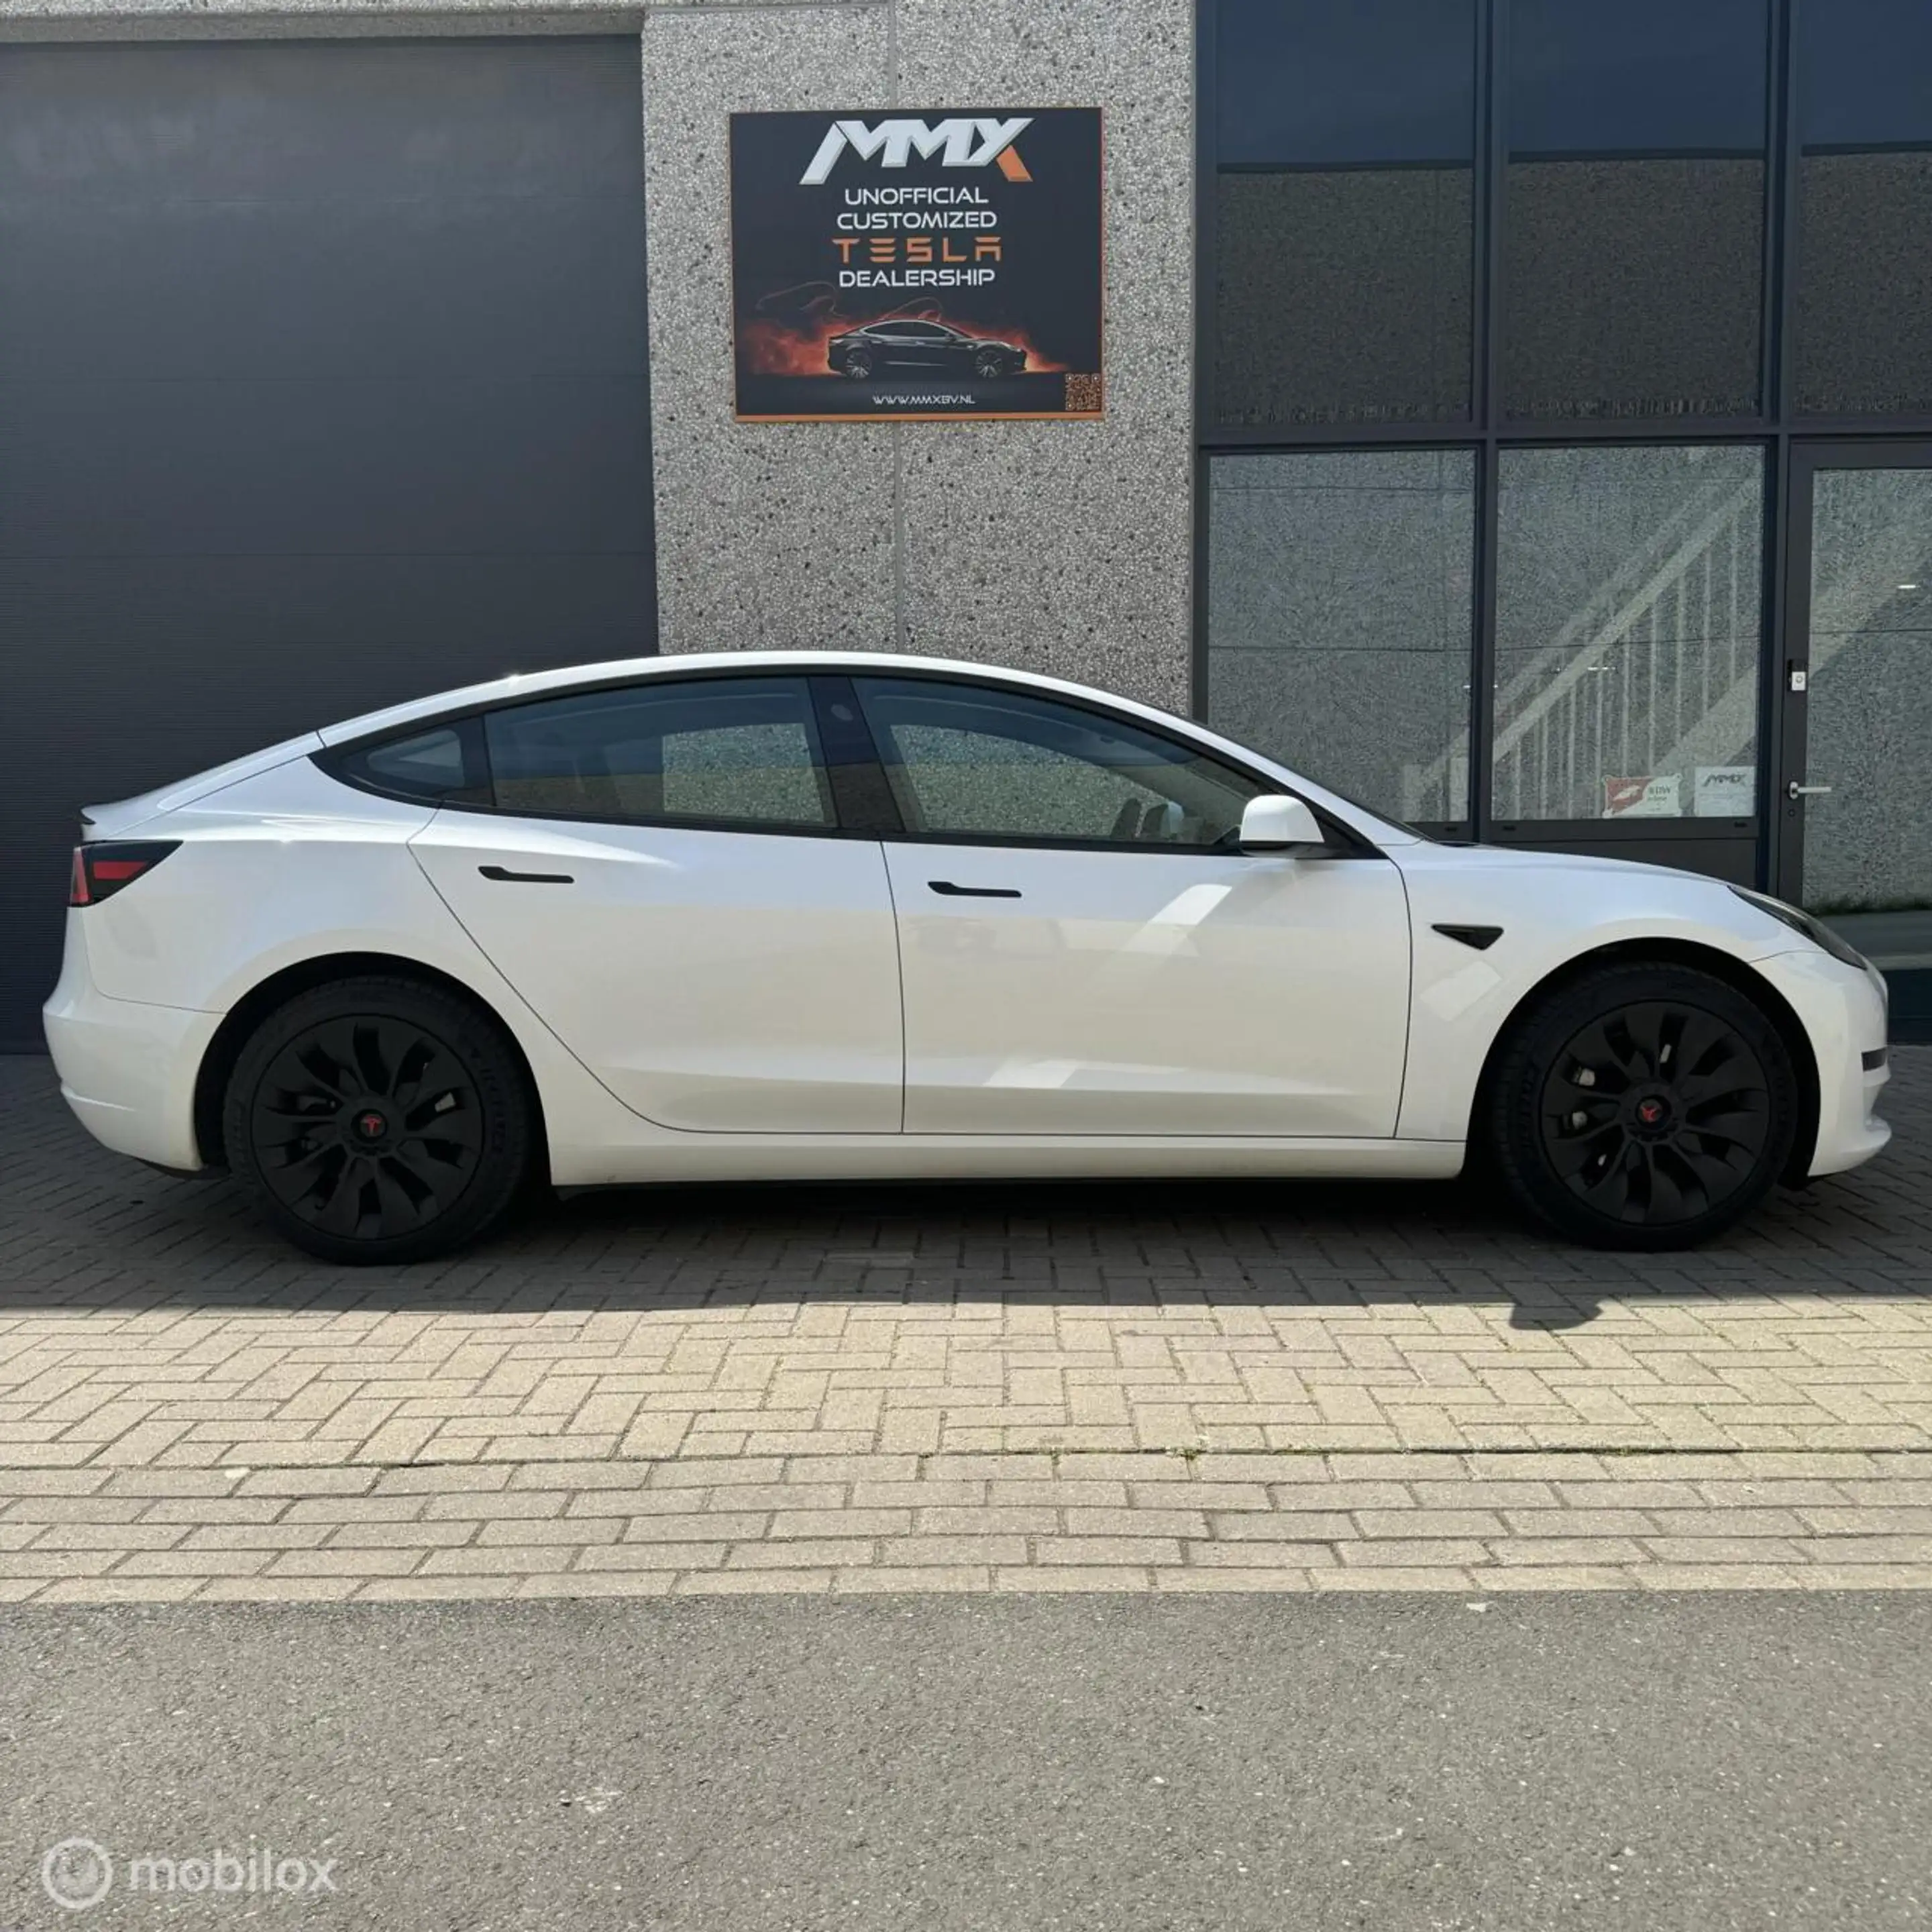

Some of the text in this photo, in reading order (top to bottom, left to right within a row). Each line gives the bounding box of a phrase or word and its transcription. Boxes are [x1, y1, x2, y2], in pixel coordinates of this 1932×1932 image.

[799, 118, 1035, 184] MMX
[845, 187, 989, 205] UNOFFICIAL
[836, 211, 998, 229] CUSTOMIZED
[832, 237, 1002, 264] TESLA
[839, 269, 996, 288] DEALERSHIP
[872, 394, 975, 405] WWW.MMXBV.NL
